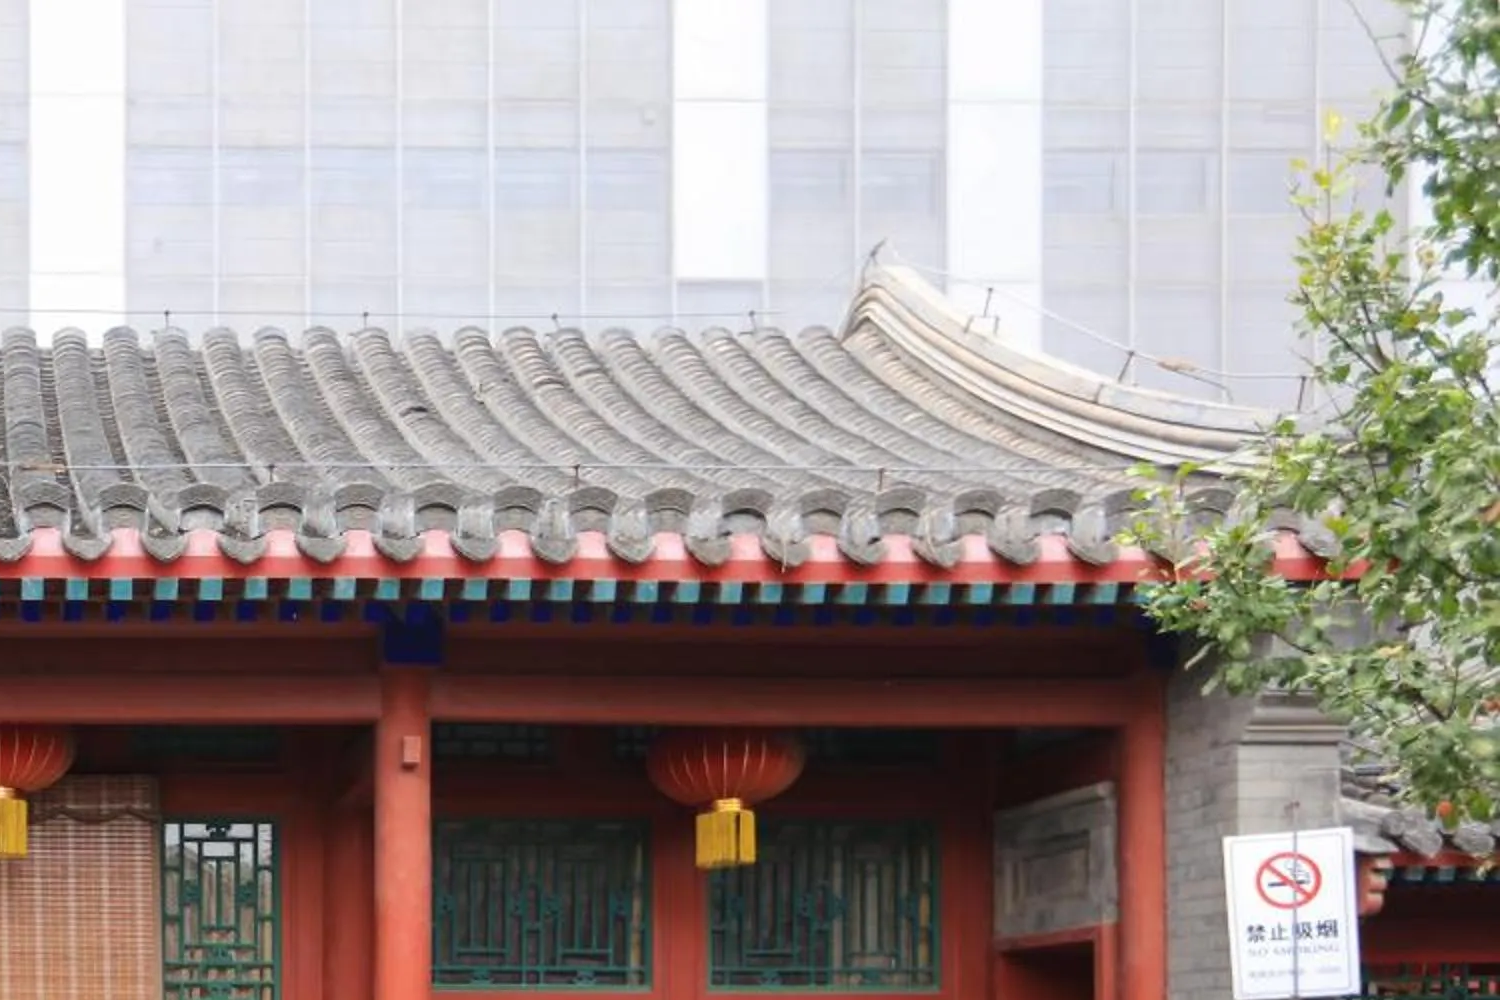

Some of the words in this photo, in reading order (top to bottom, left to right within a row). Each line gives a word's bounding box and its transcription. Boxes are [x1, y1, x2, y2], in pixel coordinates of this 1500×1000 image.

[1247, 919, 1339, 943] 禁止吸烟
[1248, 947, 1269, 957] NO
